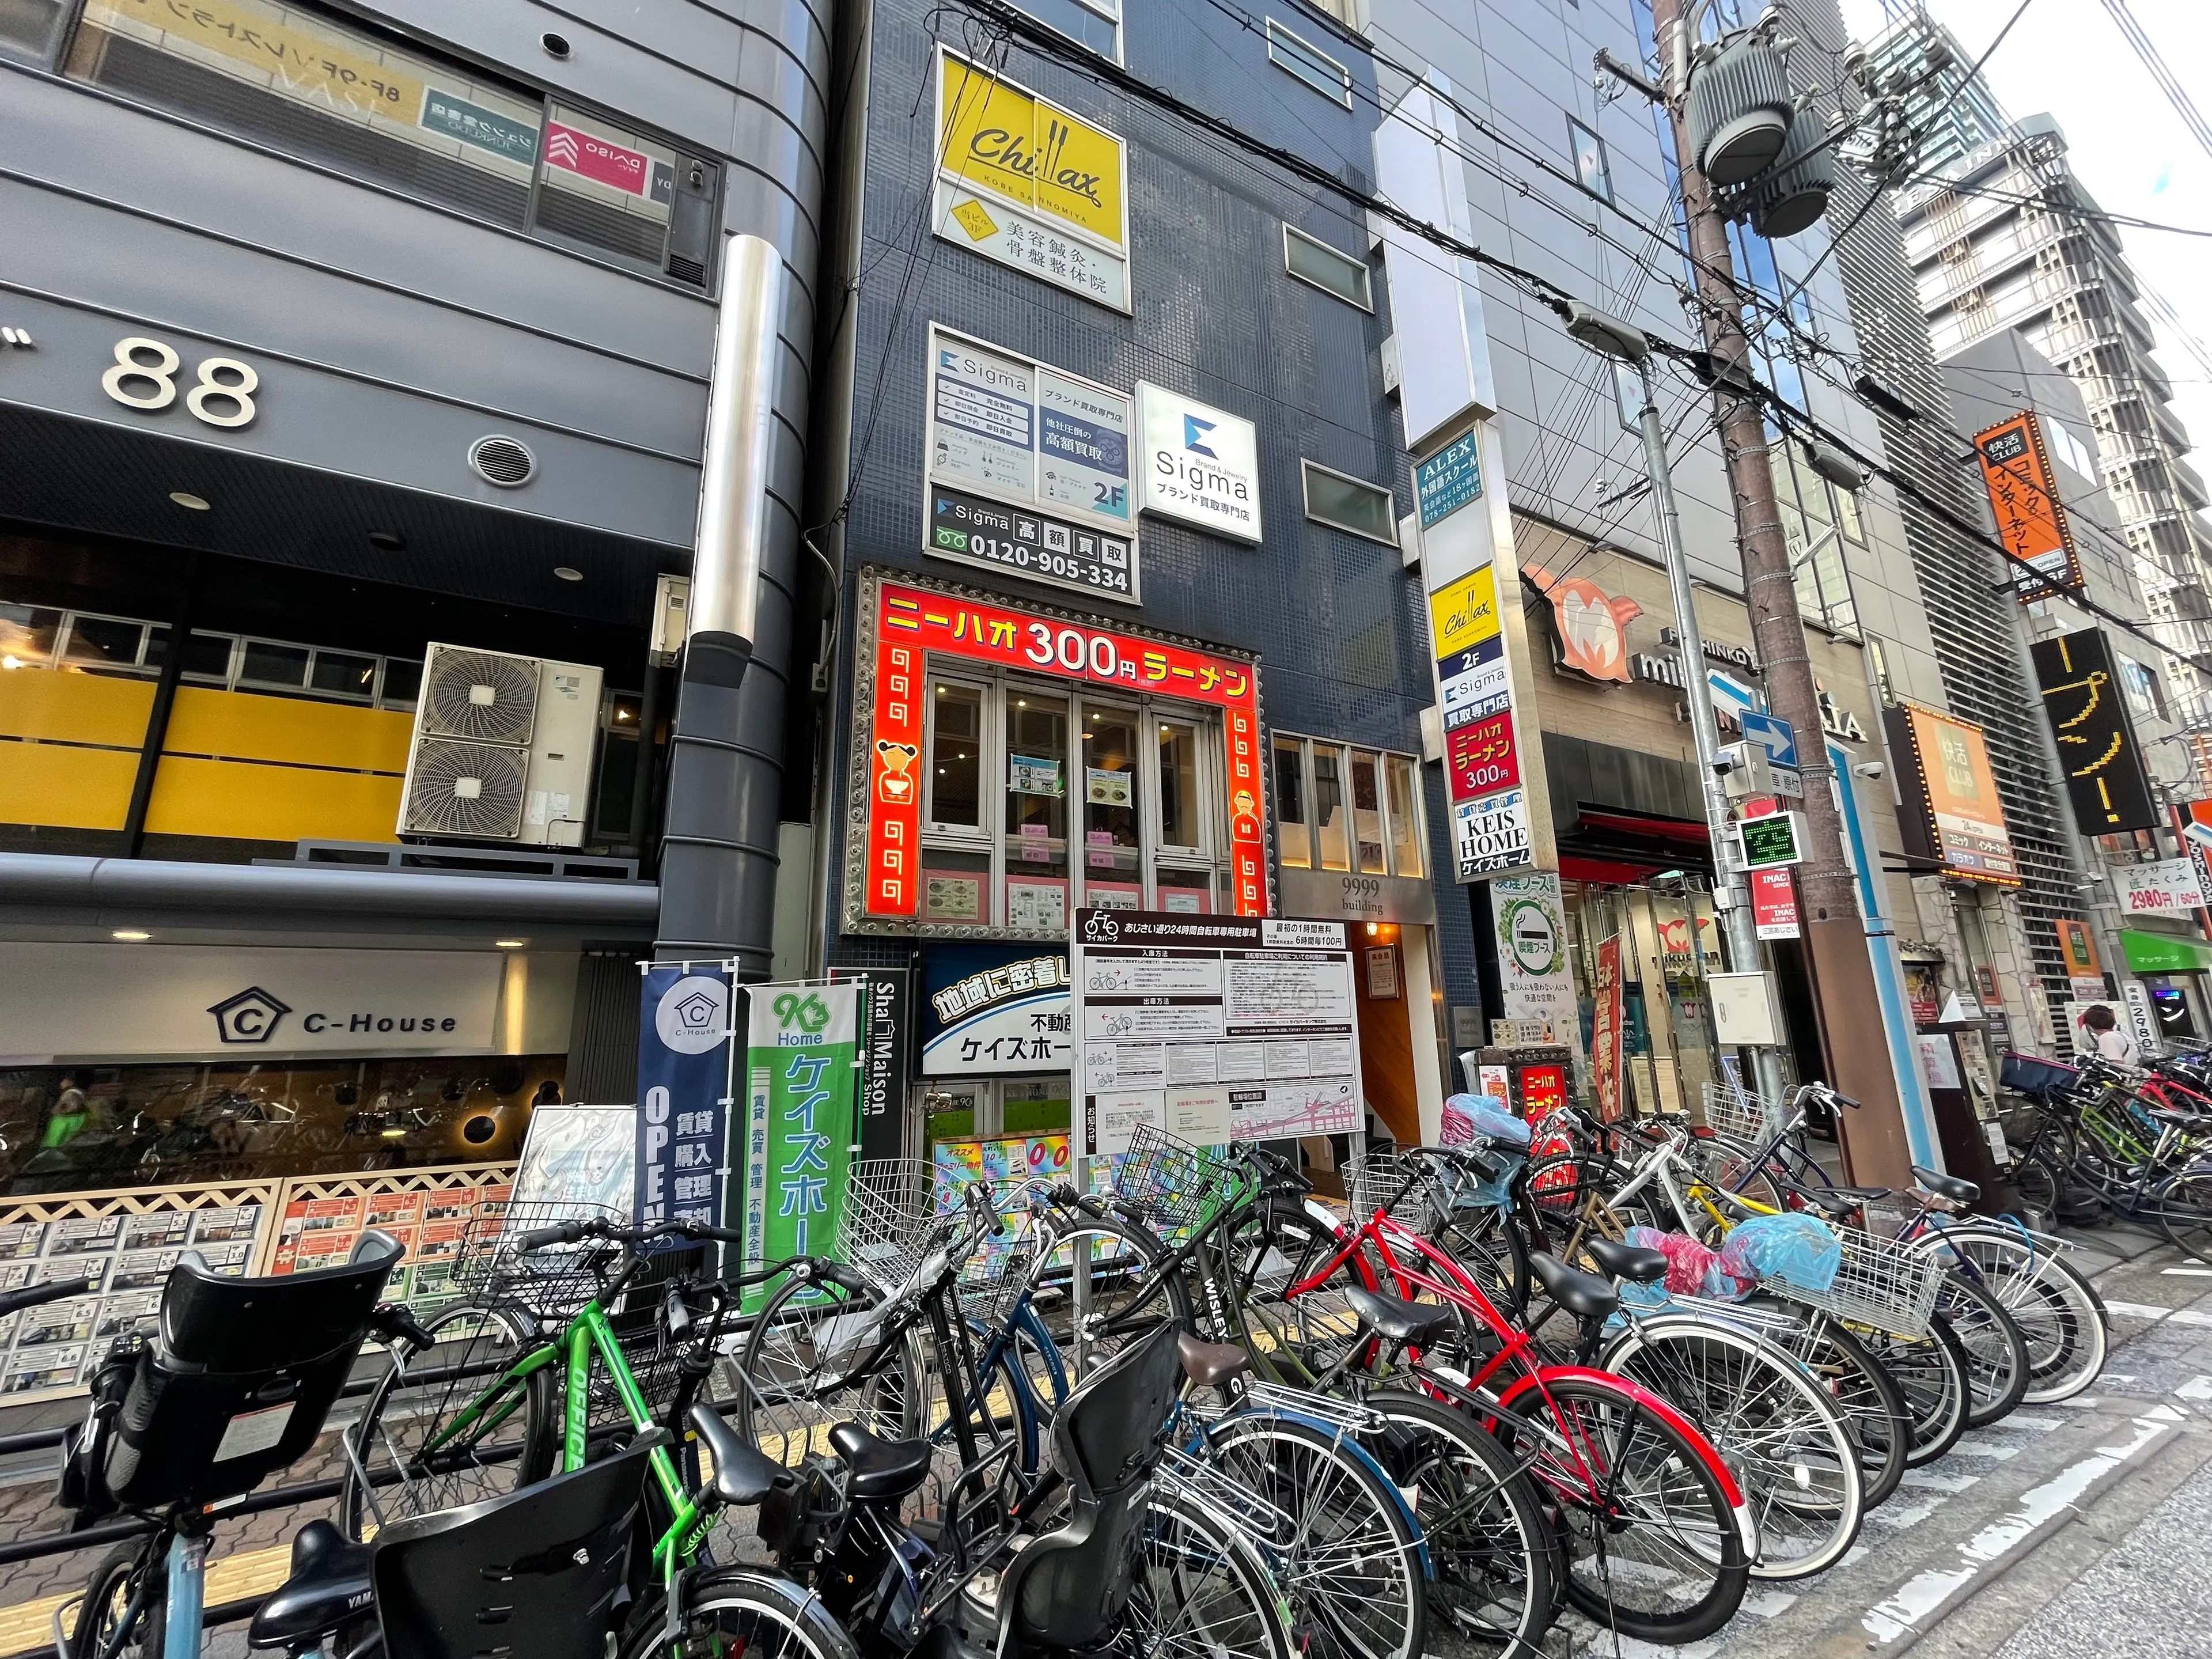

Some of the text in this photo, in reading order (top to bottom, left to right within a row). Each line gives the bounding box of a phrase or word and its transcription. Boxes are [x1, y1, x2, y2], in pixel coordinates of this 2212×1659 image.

[970, 119, 1103, 208] Chillax
[984, 175, 1088, 224] KOBE SANNOMIYA
[961, 209, 989, 226] 当ビル
[968, 222, 982, 234] 3F
[1006, 240, 1107, 294] 骨盤整体院
[102, 337, 259, 427] 88
[964, 359, 1027, 393] Sigma
[955, 400, 1013, 425] 即日現金 即日入金
[958, 389, 1013, 411] 査定料 完全無料
[1045, 389, 1124, 424] ブランド買取専門店
[955, 414, 1013, 437] 即日予約 即日買取
[1046, 417, 1092, 441] 他社圧倒の
[1046, 431, 1103, 462] 高額買取
[1988, 433, 2020, 454] 快活
[1991, 444, 2022, 461] CLUB
[1195, 459, 1215, 471] Brand
[1223, 469, 1248, 483] Jewelry
[1424, 438, 1471, 480] ALEX
[1156, 451, 1249, 501] Sigma
[1421, 454, 1478, 500] 外国語スクール
[1094, 481, 1124, 508] 2F
[1157, 483, 1250, 521] ブランド買取専門店
[1425, 483, 1480, 523] 078-251-0182
[955, 505, 1009, 531] Sigma
[1994, 468, 2030, 556] インターネット
[1018, 520, 1123, 562] 高額買取
[971, 535, 1127, 592] 0120-905-334
[2037, 556, 2061, 568] OPEN
[1444, 589, 1491, 639] Chillax
[887, 597, 1248, 696] ニーハオ 300円 ラーメン
[1461, 652, 1480, 671] 2F
[1459, 669, 1505, 695] Sigma
[1448, 693, 1510, 727] 買取専門店
[1456, 722, 1502, 748] ニーハオ
[1942, 740, 1968, 766] 快活
[1465, 764, 1509, 789] 300円
[1948, 766, 1973, 787] CLUB
[1467, 810, 1515, 837] KEIS
[1460, 827, 1528, 859] HOME
[1949, 834, 2009, 856] コミック インターネット
[1462, 849, 1531, 876] ケイズホーム
[1951, 852, 1975, 865] カラオケ
[2123, 861, 2187, 876] マッサージ
[1342, 877, 1380, 897] 9999
[1762, 873, 1786, 884] INAC
[1342, 899, 1383, 916] building
[2129, 889, 2173, 910] 2980円
[1774, 908, 1794, 917] INAC
[1086, 934, 1118, 943] サイカパーク
[1124, 922, 1257, 938] あじさい通り24時間自転車専用駐車場
[1276, 923, 1332, 934] 最初の1時間無料
[1296, 935, 1342, 946] 6時間毎100円
[1142, 949, 1169, 957] 入庫方法
[1518, 941, 1550, 954] 喫煙ブース
[1509, 982, 1568, 991] 吸う人にも吸わない人にも
[1524, 994, 1556, 1002] 快適な空間を
[304, 1013, 456, 1033] C-House
[675, 1028, 716, 1037] C-House
[2133, 1007, 2153, 1048] 2980
[778, 1032, 823, 1047] Home
[871, 1041, 893, 1116] Maison
[1527, 1075, 1555, 1089] ニーハオ
[862, 1084, 873, 1116] Shop
[1527, 1094, 1562, 1115] ラーメン
[676, 1109, 714, 1136] 賃貸
[1087, 1107, 1095, 1143] お知らせ
[675, 1142, 713, 1168] 購入
[946, 1147, 974, 1157] オススメ
[986, 1153, 995, 1161] 10
[640, 1086, 671, 1244] OPEN
[675, 1174, 712, 1202] 管理
[747, 1094, 765, 1266] 賃貸 売買 管理 不動産全般
[173, 1218, 187, 1226] 5.3
[1203, 1277, 1230, 1339] WISLEY
[570, 1366, 588, 1469] OFFICE
[680, 1446, 691, 1495] Panasonic
[348, 1590, 374, 1609] YAM
